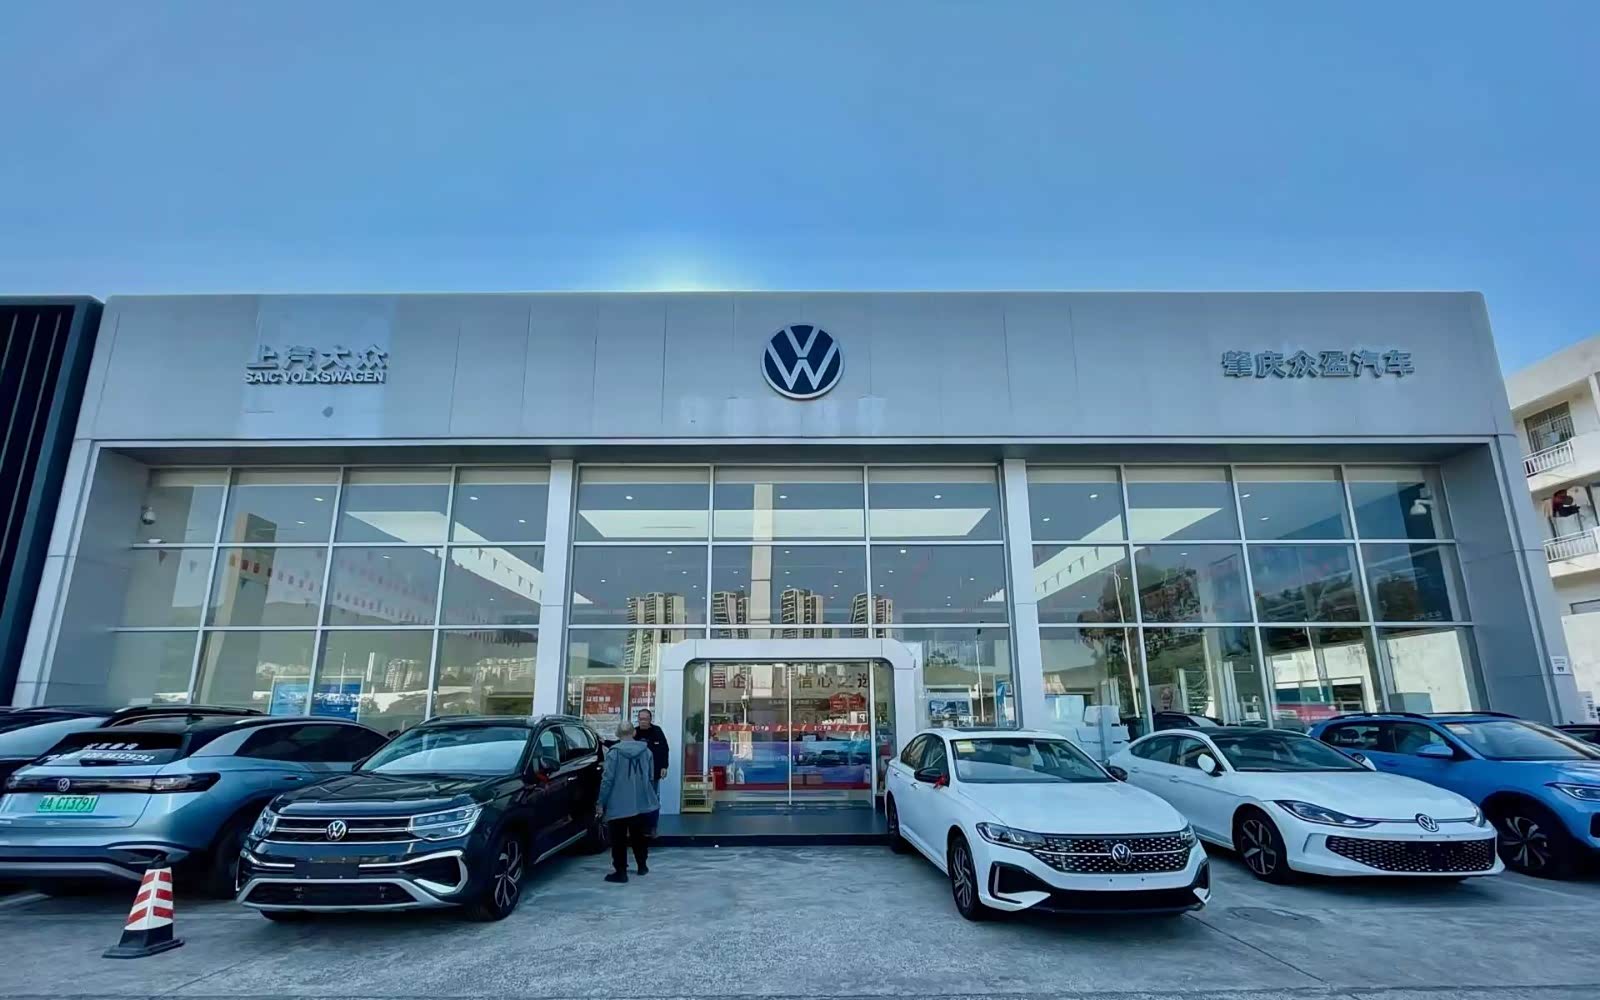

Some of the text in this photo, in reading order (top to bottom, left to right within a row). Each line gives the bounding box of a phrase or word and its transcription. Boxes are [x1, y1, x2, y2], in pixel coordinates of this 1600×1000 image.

[1222, 349, 1415, 378] 肇庆众盈汽车
[281, 371, 386, 384] VOLKSWAGEN
